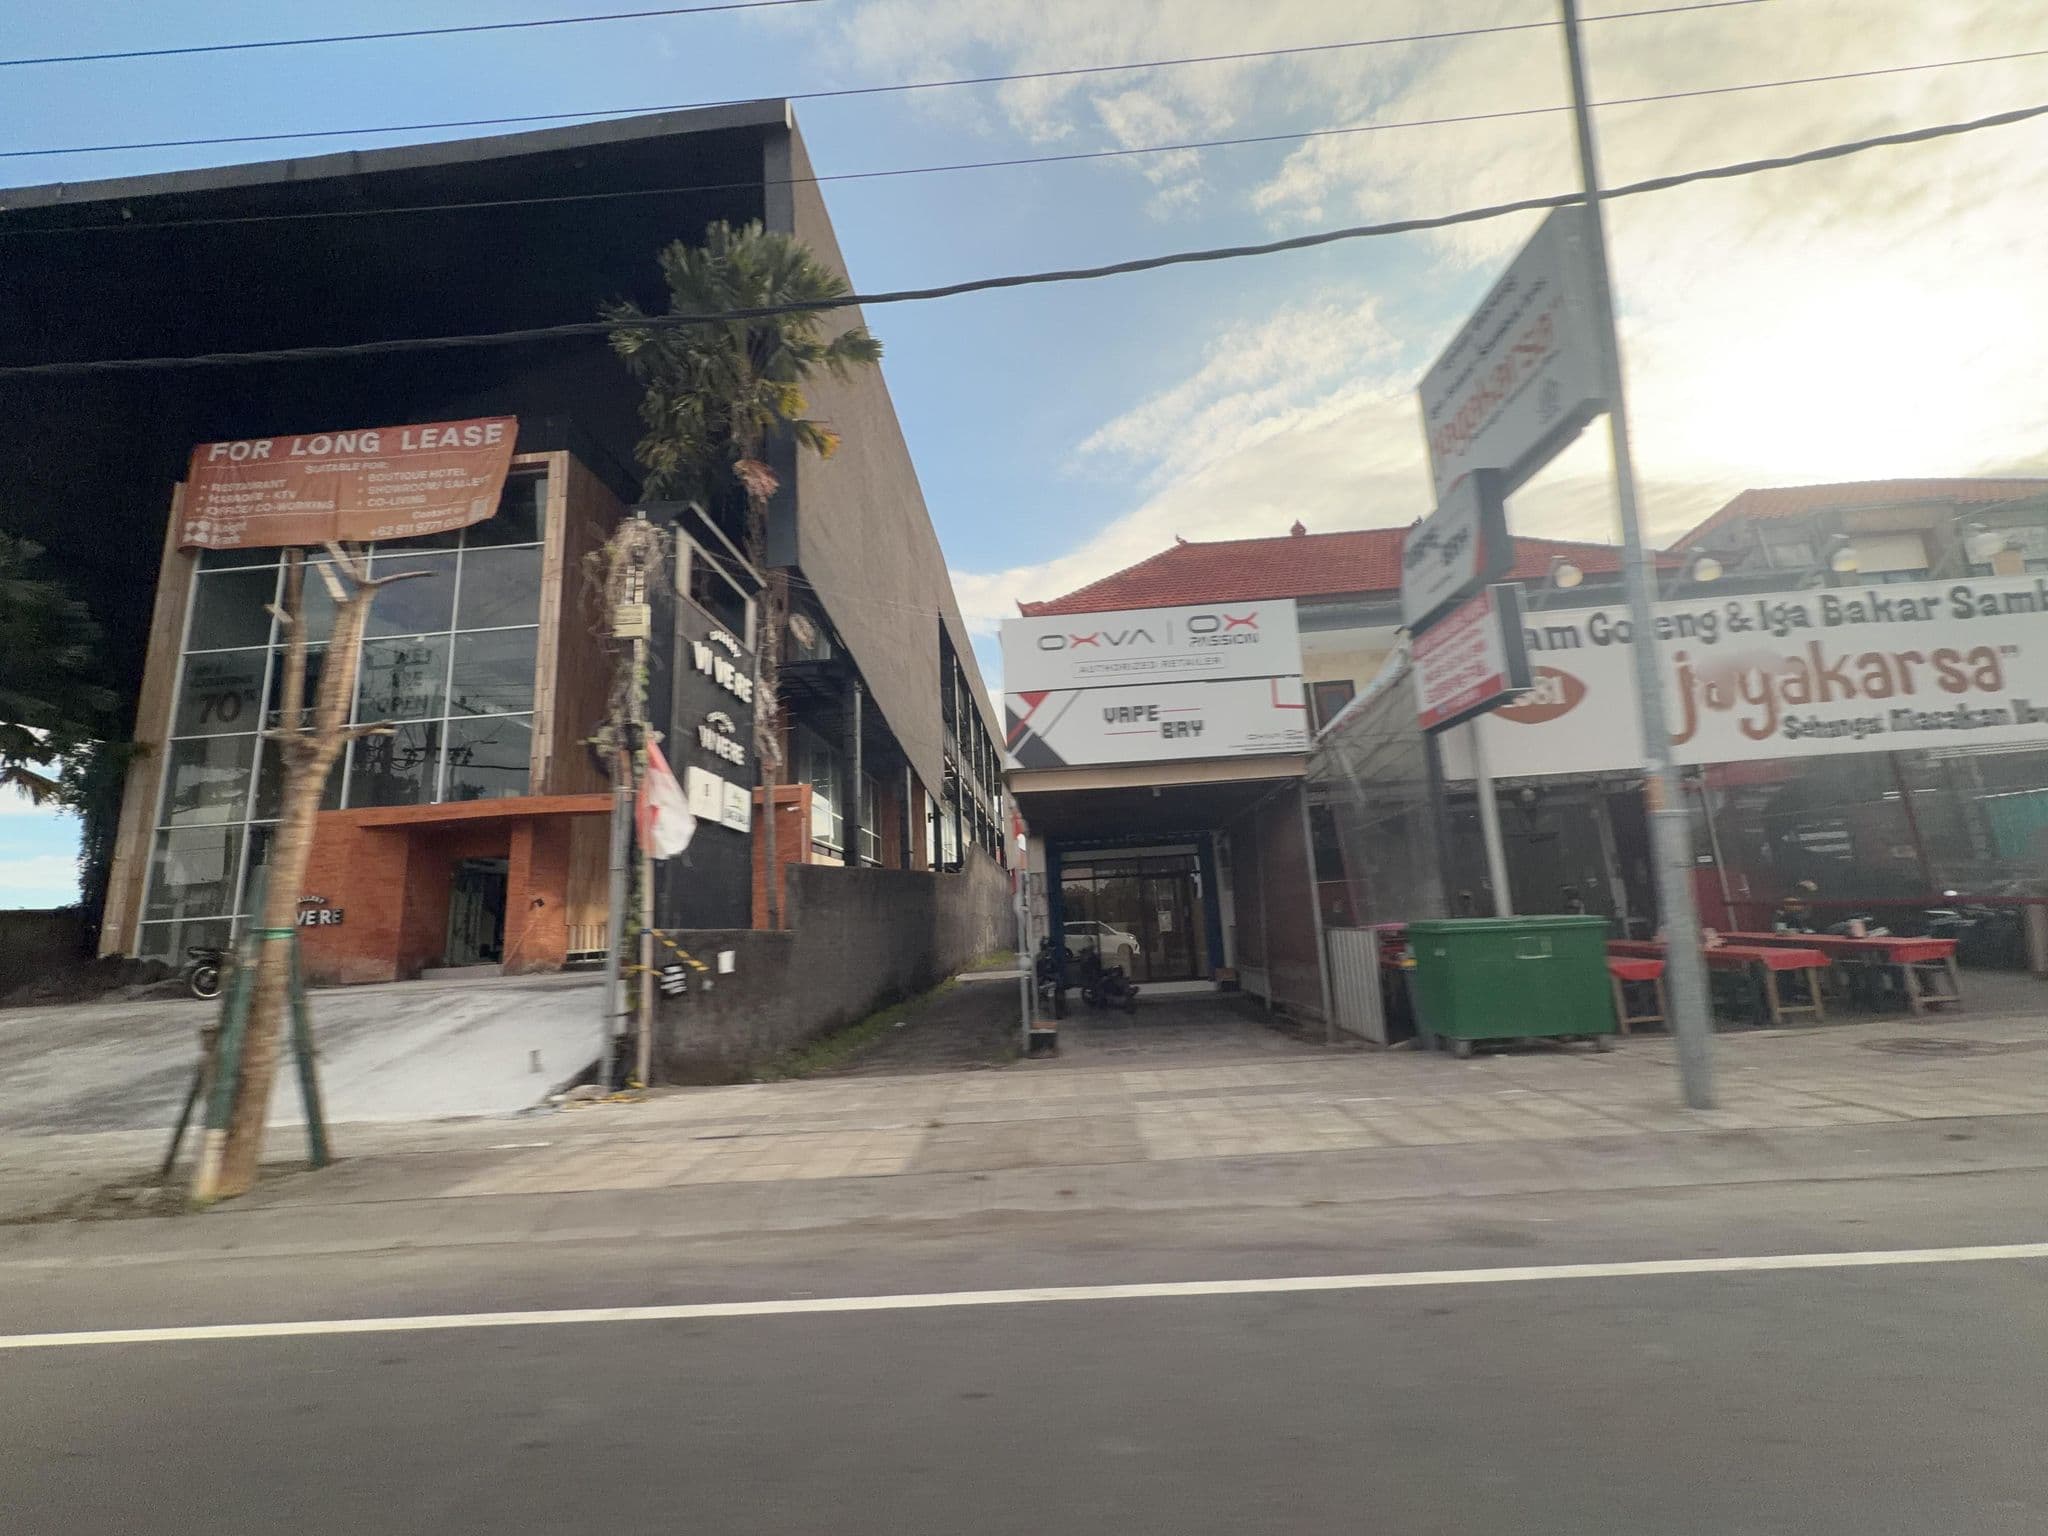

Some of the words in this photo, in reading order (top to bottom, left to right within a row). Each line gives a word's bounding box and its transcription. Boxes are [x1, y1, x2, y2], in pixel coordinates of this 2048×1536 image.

[207, 440, 273, 462] FOR
[291, 432, 381, 457] LONG
[401, 423, 504, 450] LEASE
[1523, 625, 1582, 650] am
[1588, 609, 1717, 645] Goeng
[1819, 590, 1941, 628] Bakar
[1037, 628, 1155, 651] OXVA
[1102, 705, 1160, 724] VAPE
[295, 909, 344, 926] VERE
